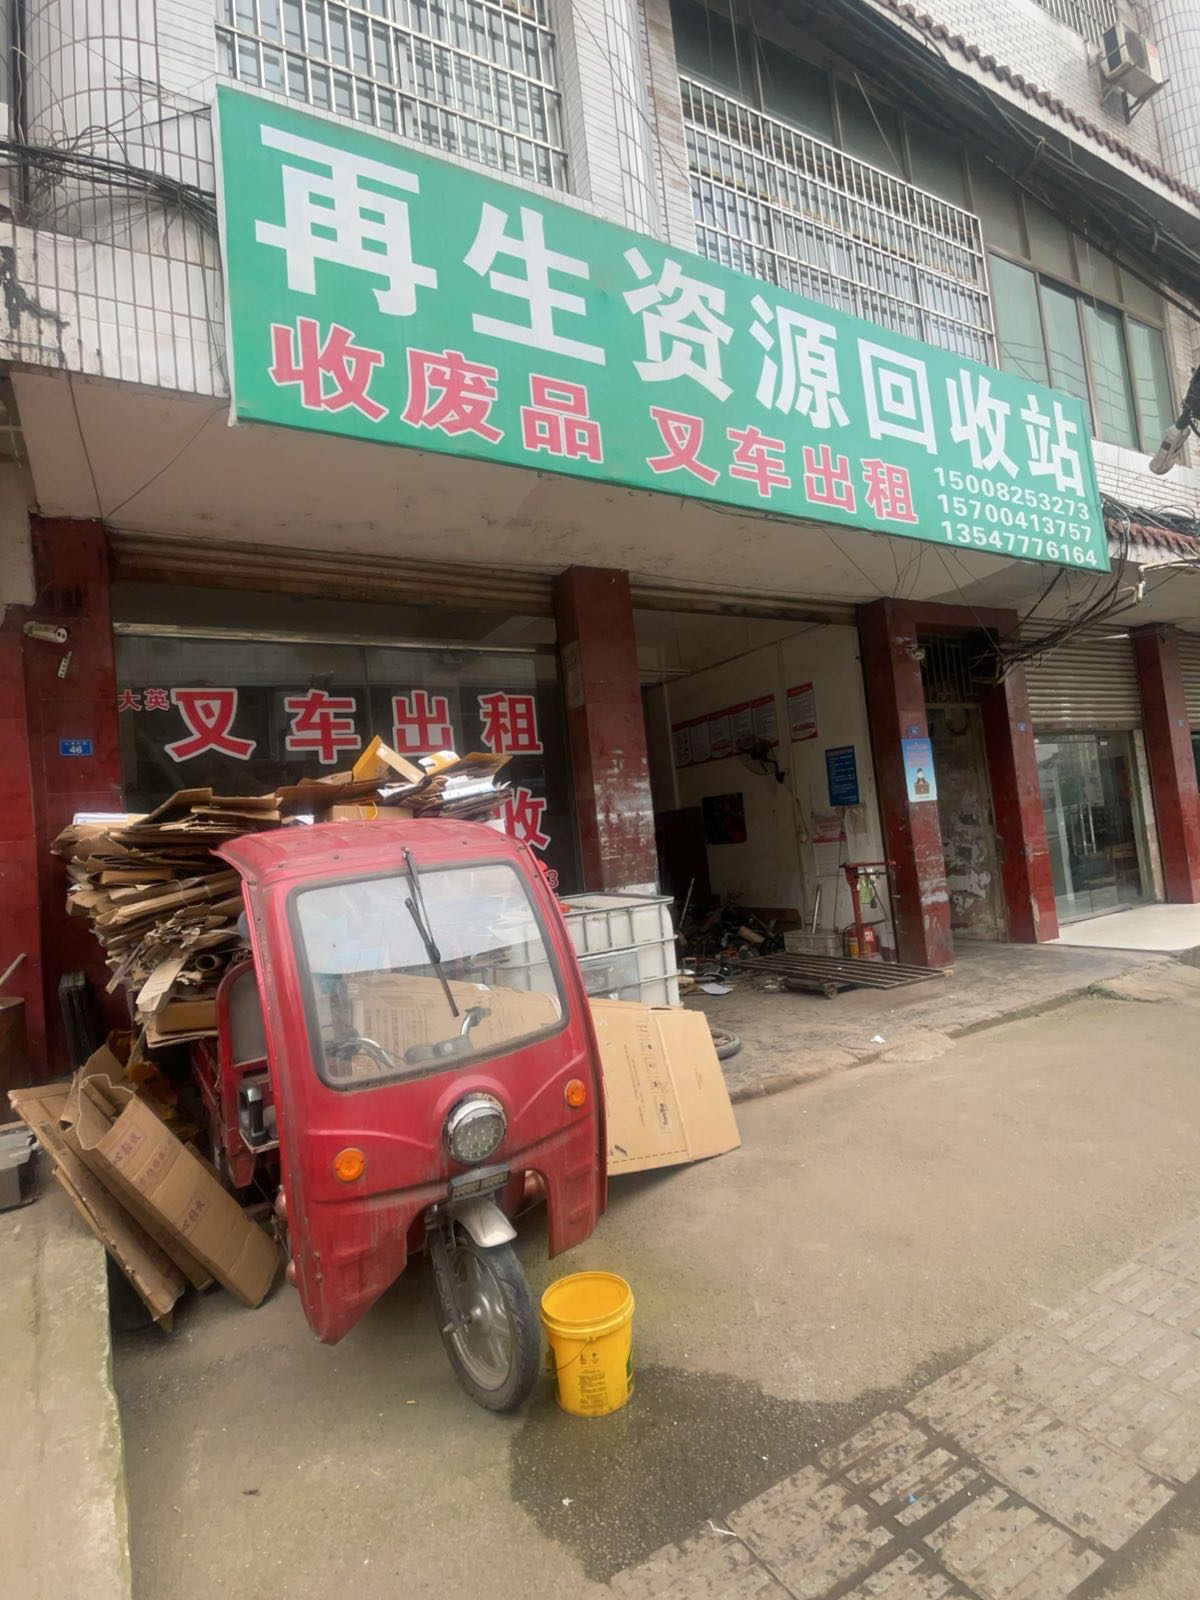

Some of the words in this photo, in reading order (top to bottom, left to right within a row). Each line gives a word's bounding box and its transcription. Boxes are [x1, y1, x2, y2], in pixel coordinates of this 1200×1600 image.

[255, 124, 1086, 497] 再生资源回收站
[268, 316, 604, 463] 收废品
[646, 405, 919, 525] 叉车出租
[934, 466, 1090, 521] 15008253273
[937, 494, 1093, 543] 15700413757
[940, 520, 1098, 567] 13547776164
[118, 688, 170, 713] 大英
[164, 687, 544, 765] 叉车出租
